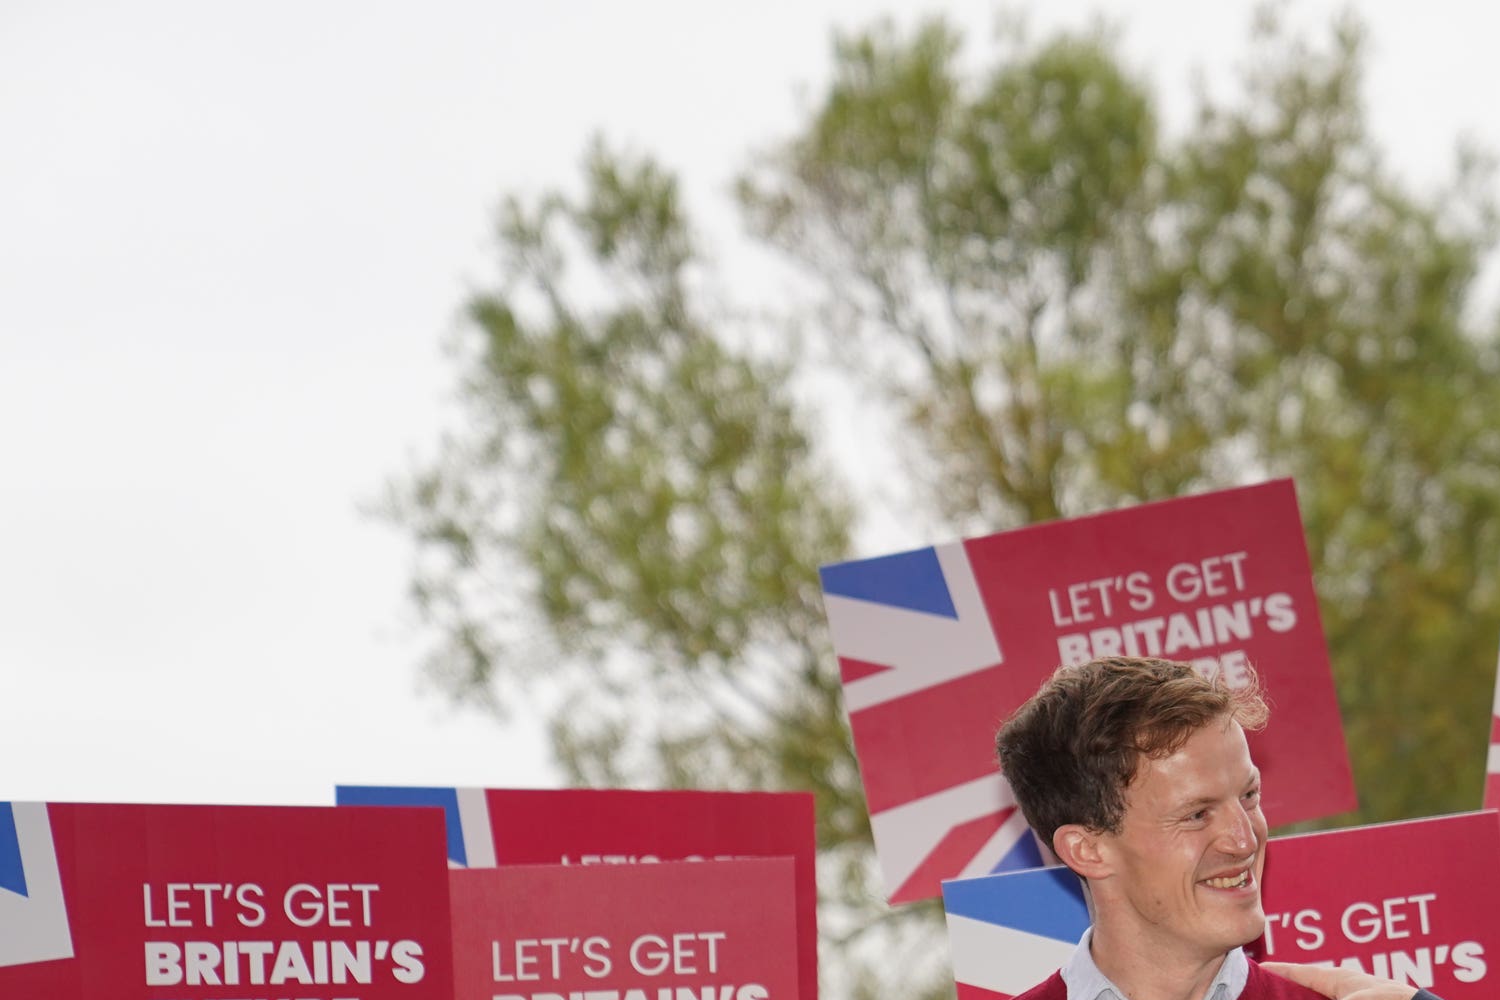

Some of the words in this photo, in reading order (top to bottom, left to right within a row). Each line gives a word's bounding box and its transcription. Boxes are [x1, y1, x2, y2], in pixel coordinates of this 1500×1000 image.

[1049, 571, 1154, 627] LET'S
[1166, 551, 1248, 602] GET
[1057, 592, 1297, 667] BRITAIN'S
[143, 883, 266, 927] LET'S
[284, 884, 380, 926] GET
[1264, 909, 1324, 956] T'S
[1341, 893, 1436, 943] GET
[145, 940, 424, 986] BRITAIN'S
[492, 936, 612, 981] LET'S
[629, 932, 726, 976] GET
